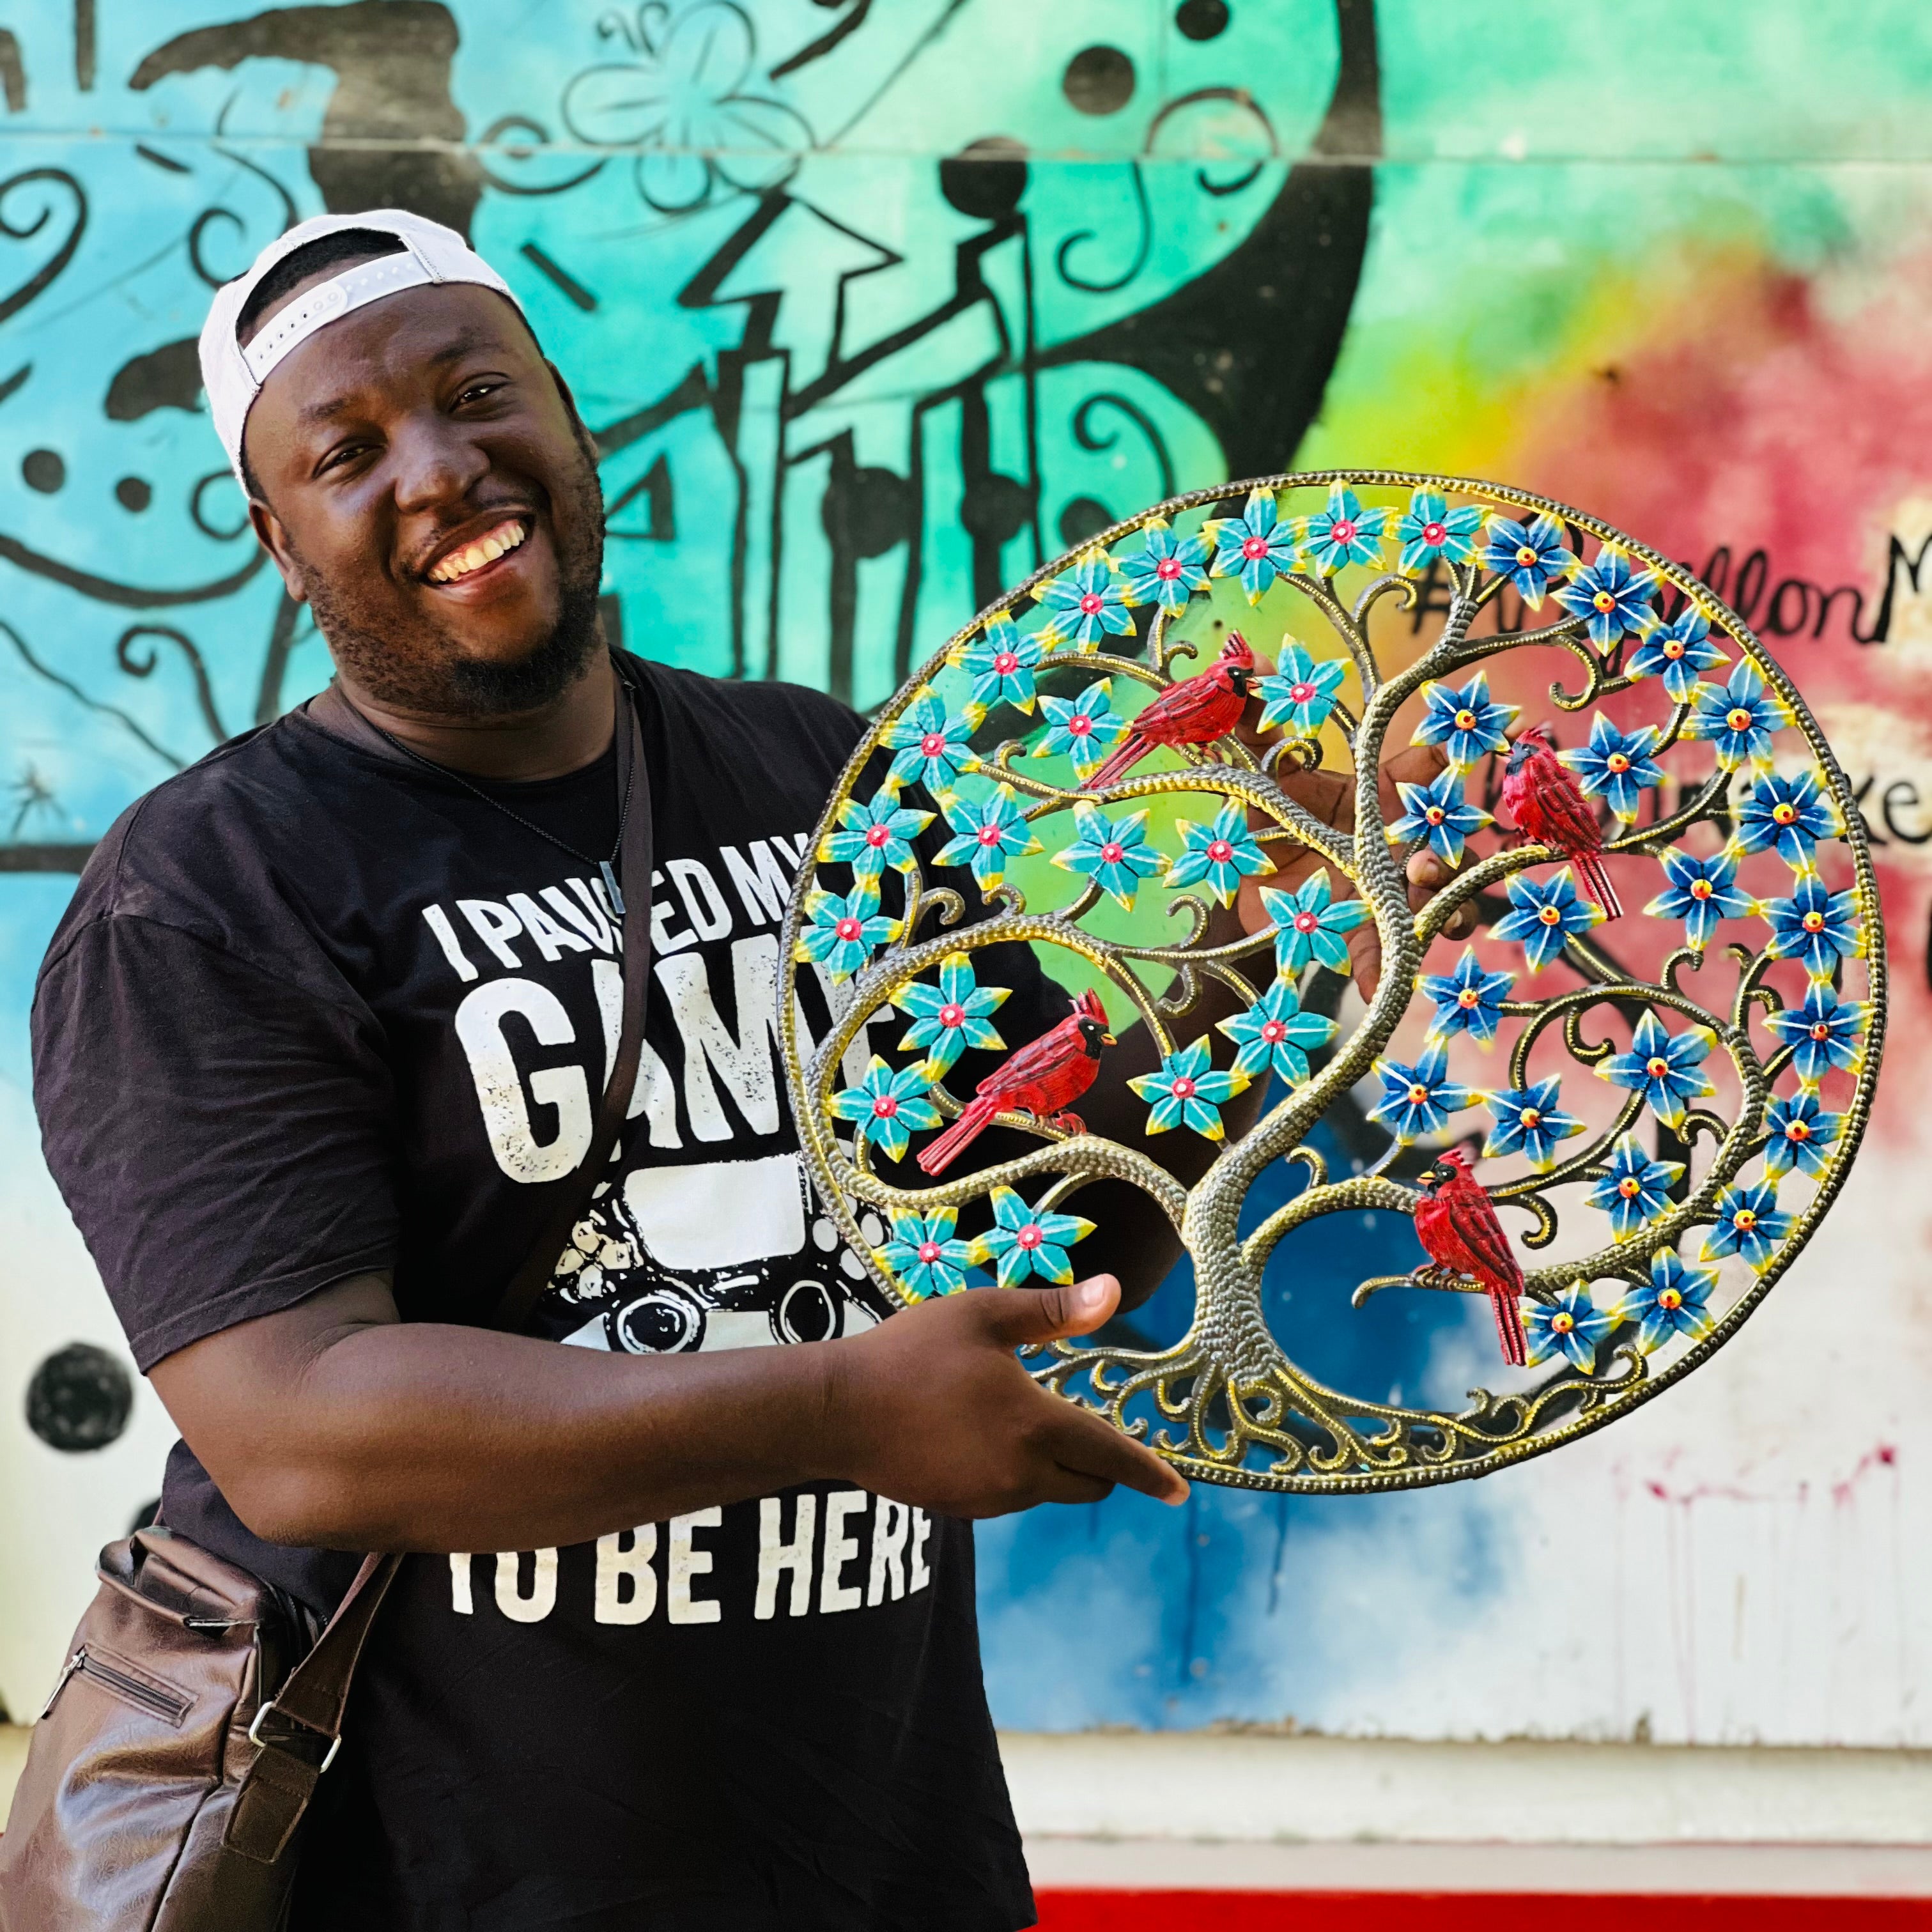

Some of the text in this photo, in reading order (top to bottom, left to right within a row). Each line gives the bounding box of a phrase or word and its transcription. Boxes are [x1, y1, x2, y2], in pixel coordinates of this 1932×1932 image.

[422, 904, 478, 982] I
[594, 1506, 722, 1625] BE
[754, 1490, 932, 1621] HERE
